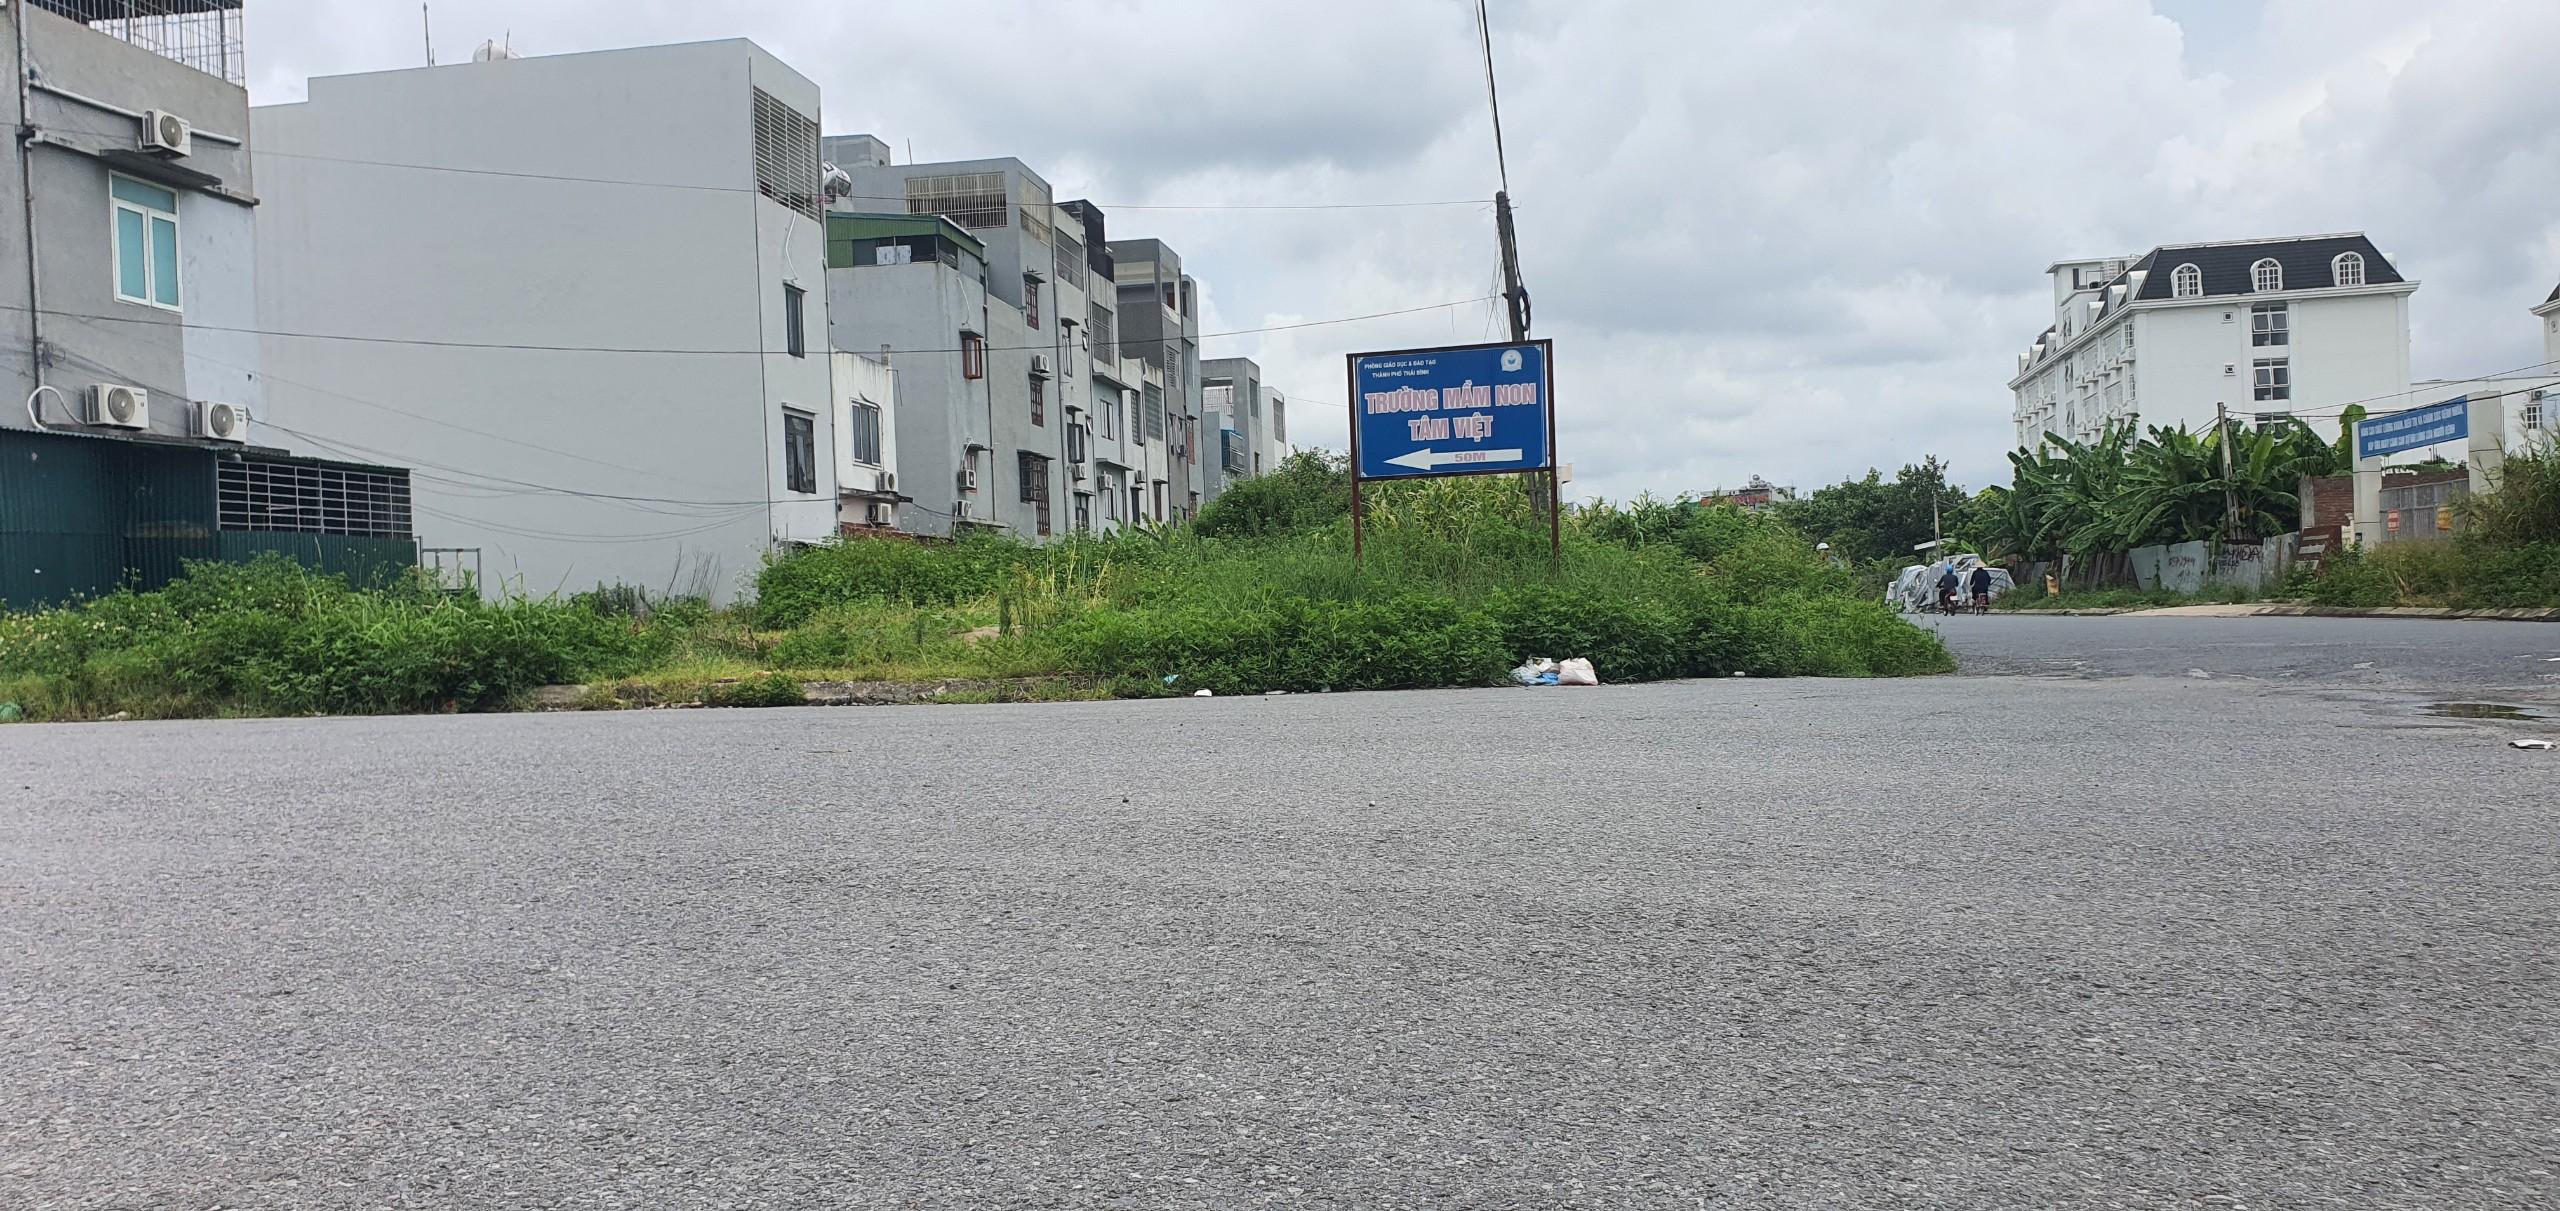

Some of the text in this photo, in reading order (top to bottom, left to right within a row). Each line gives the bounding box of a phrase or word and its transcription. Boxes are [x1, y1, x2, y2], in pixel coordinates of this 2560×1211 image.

[1365, 386, 1438, 414] TRƯỜNG
[1495, 383, 1536, 406] NON
[1408, 412, 1494, 442] TÂM VIỆT
[1455, 452, 1486, 462] 50M
